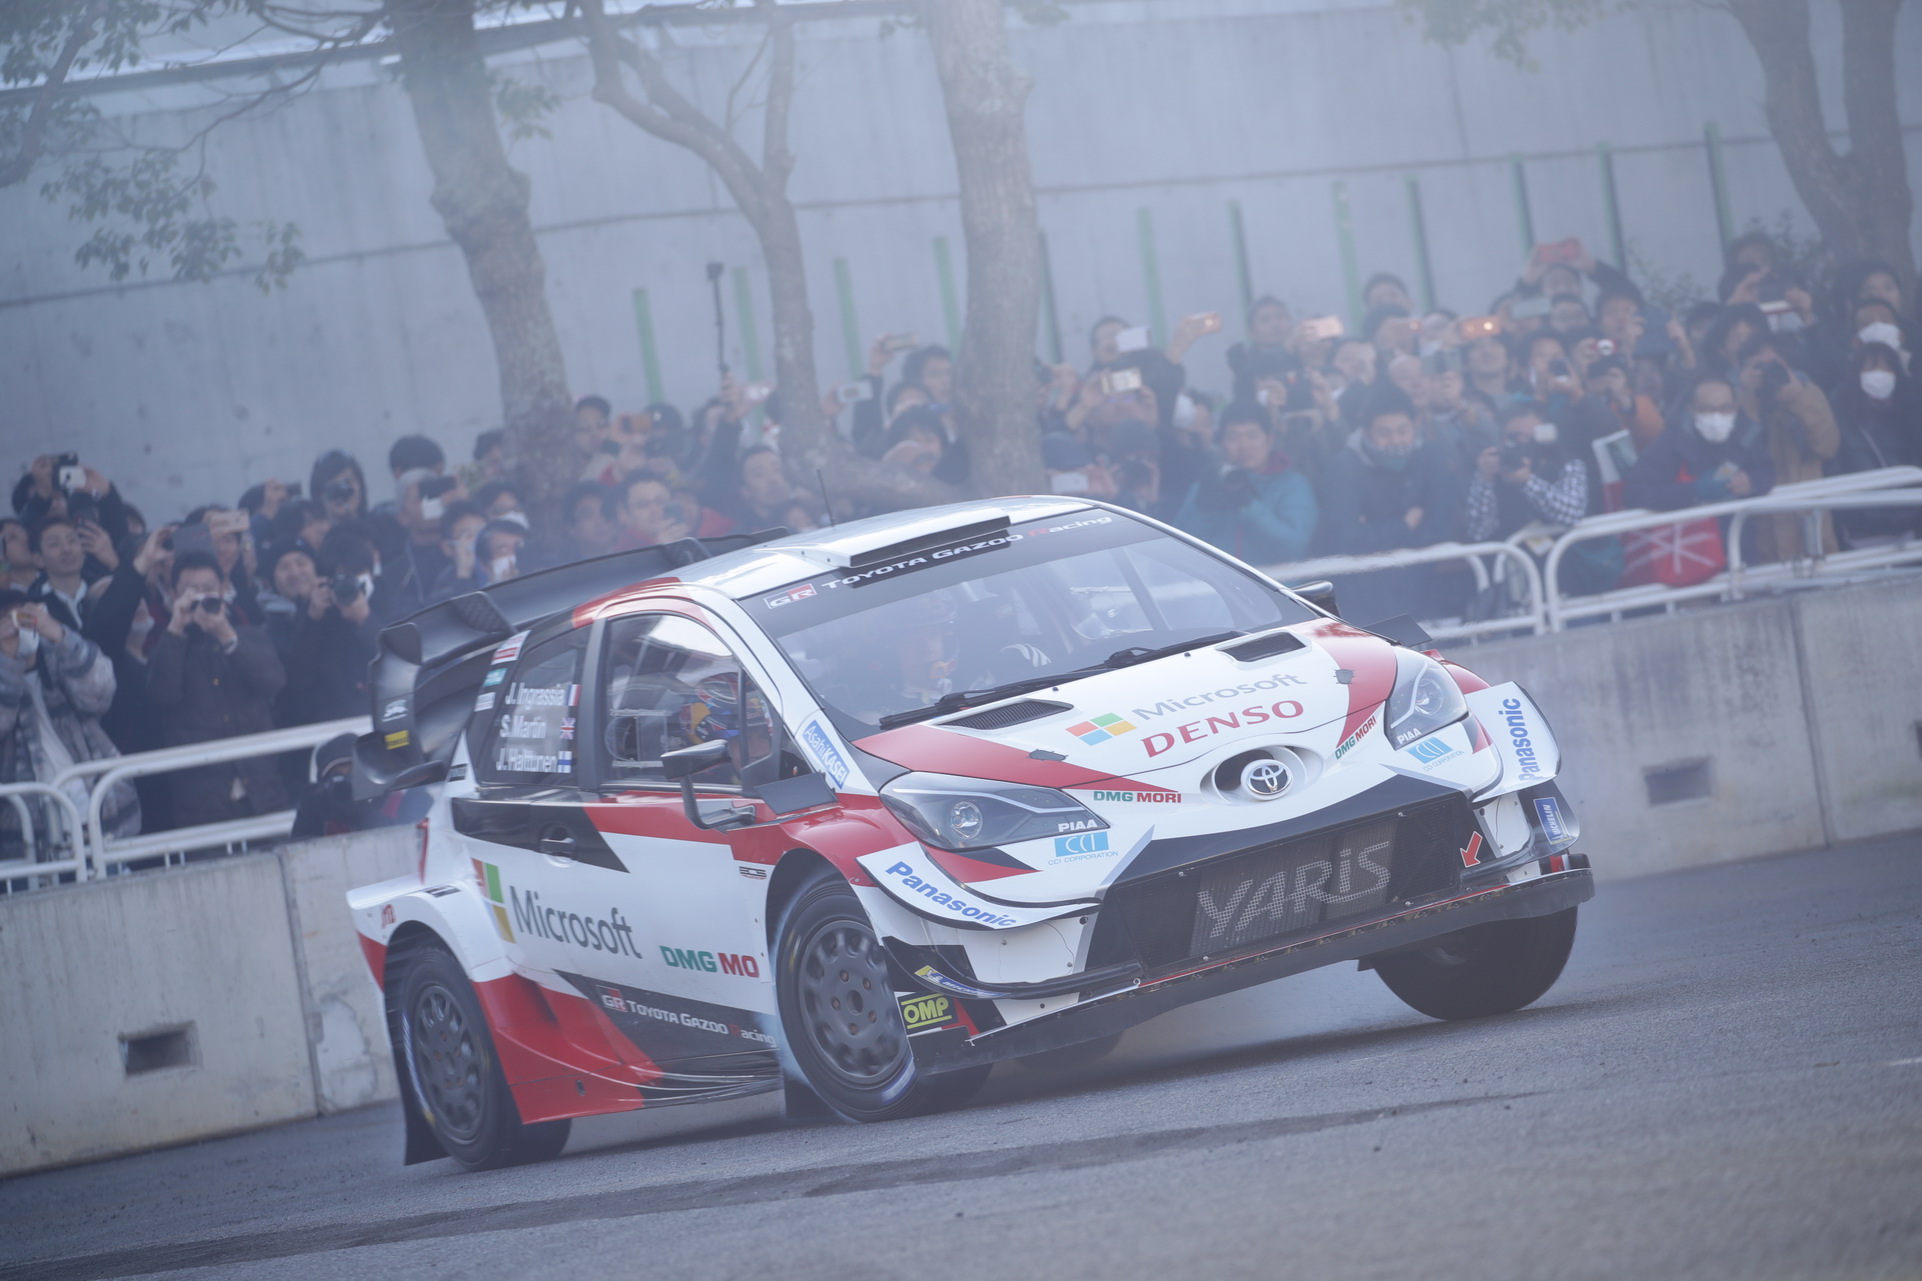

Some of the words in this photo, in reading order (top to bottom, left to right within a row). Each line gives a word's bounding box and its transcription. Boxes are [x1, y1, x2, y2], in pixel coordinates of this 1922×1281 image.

[770, 587, 813, 607] GR
[822, 557, 927, 588] TOYOTA
[932, 534, 1024, 560] GAZOO
[1028, 516, 1113, 537] Racing
[1132, 674, 1309, 720] Microsoft
[1141, 700, 1304, 758] DENSO
[1335, 736, 1356, 760] DMG
[1355, 715, 1377, 742] MORI
[1396, 728, 1422, 744] PIAA
[1498, 698, 1543, 782] Panasonic
[1093, 791, 1134, 802] DMG
[1136, 792, 1182, 803] MORI
[1058, 819, 1098, 832] PIAA
[1064, 851, 1119, 863] CORPORATION
[885, 861, 1017, 927] Panasonic
[509, 885, 643, 959] Microsoft
[659, 945, 718, 973] DMG
[717, 952, 760, 978] MO
[601, 994, 626, 1010] GR
[626, 1000, 679, 1024] TOYOTA
[680, 1013, 729, 1035] GAZOO
[729, 1024, 776, 1048] Racing
[903, 997, 949, 1024] OMP
